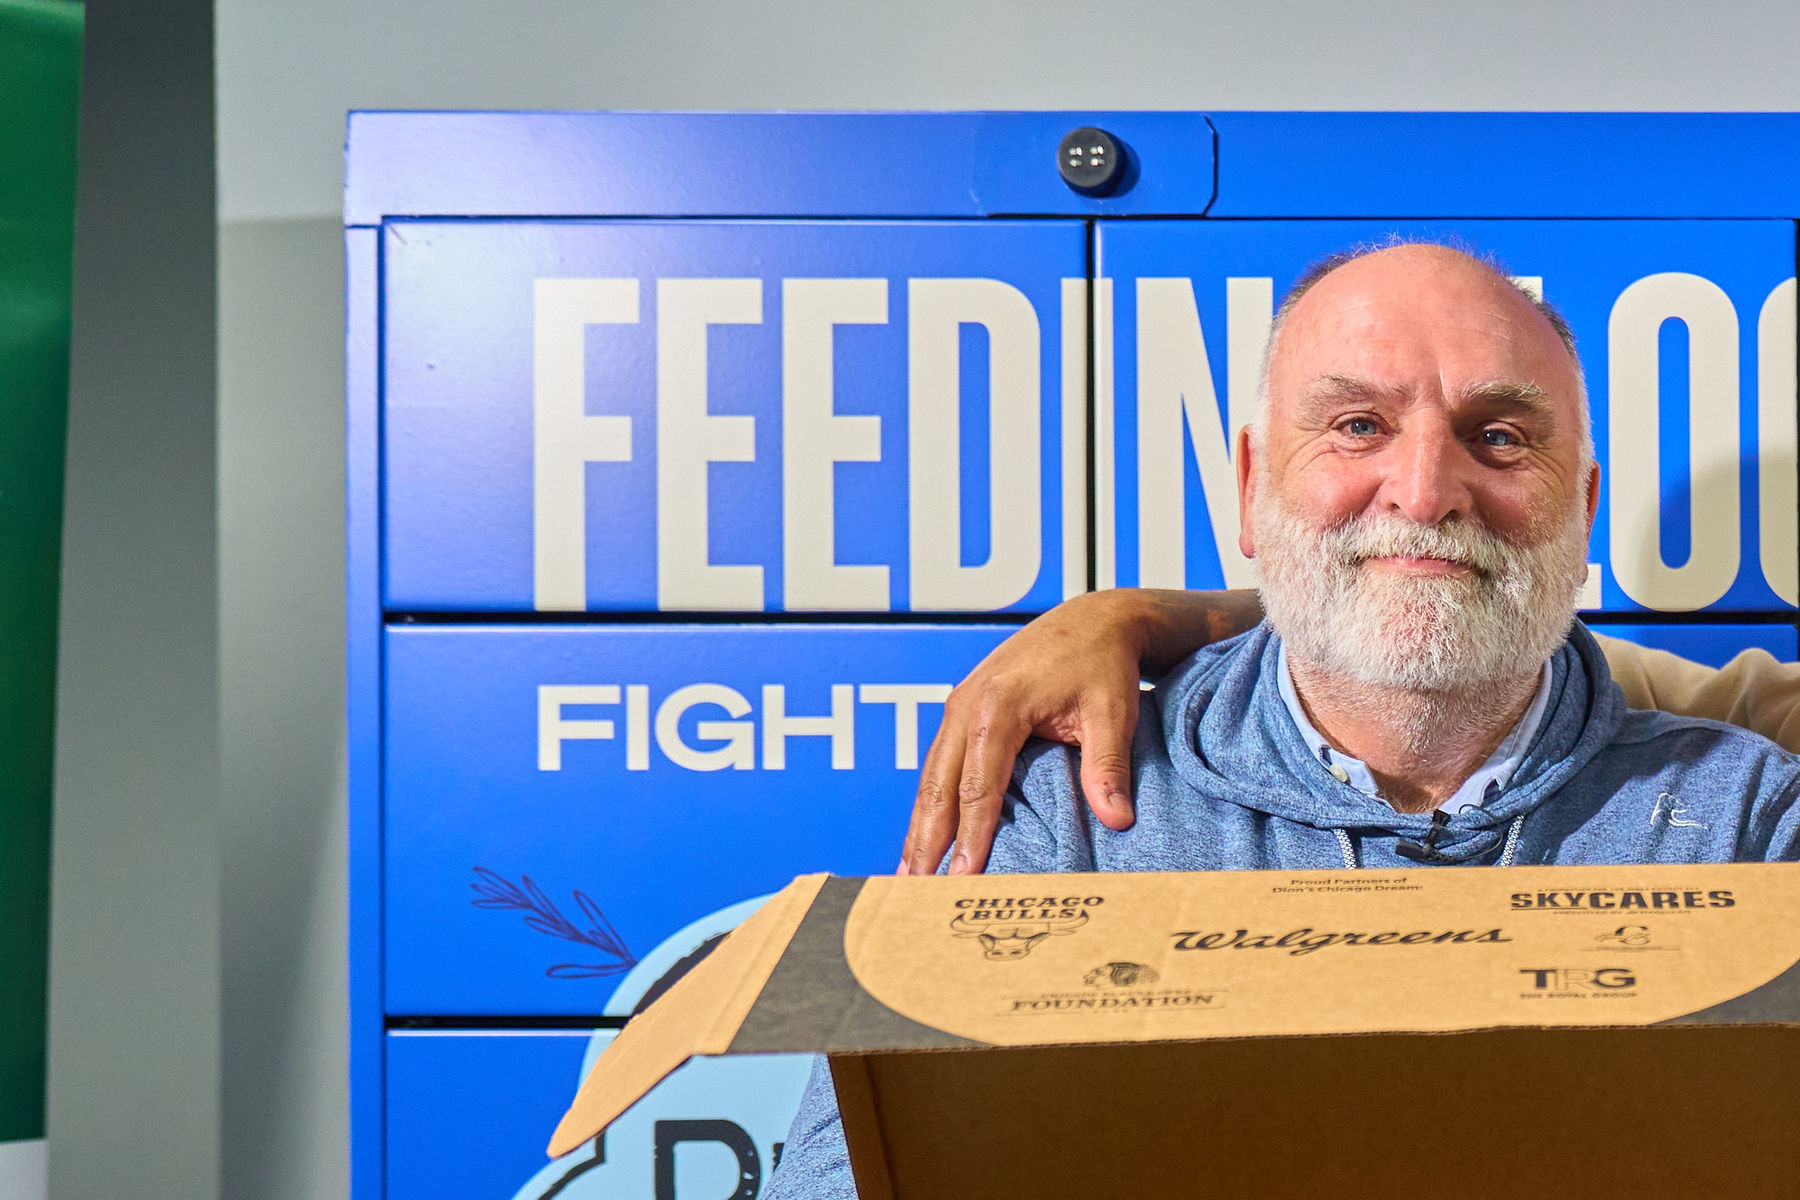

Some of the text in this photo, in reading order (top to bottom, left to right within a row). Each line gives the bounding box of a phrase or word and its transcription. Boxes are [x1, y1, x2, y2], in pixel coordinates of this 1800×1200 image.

[533, 277, 1273, 611] FEEDIN
[538, 683, 954, 772] FIGHT
[1290, 878, 1333, 886] Proud
[1317, 885, 1372, 893] Chicago
[954, 896, 1105, 909] CHICAGO
[1511, 891, 1736, 909] SKYCARES
[971, 908, 1077, 921] BULLS
[1170, 928, 1513, 956] Walgreens
[1519, 968, 1637, 991] TRG
[1012, 994, 1214, 1011] FOUNDATION
